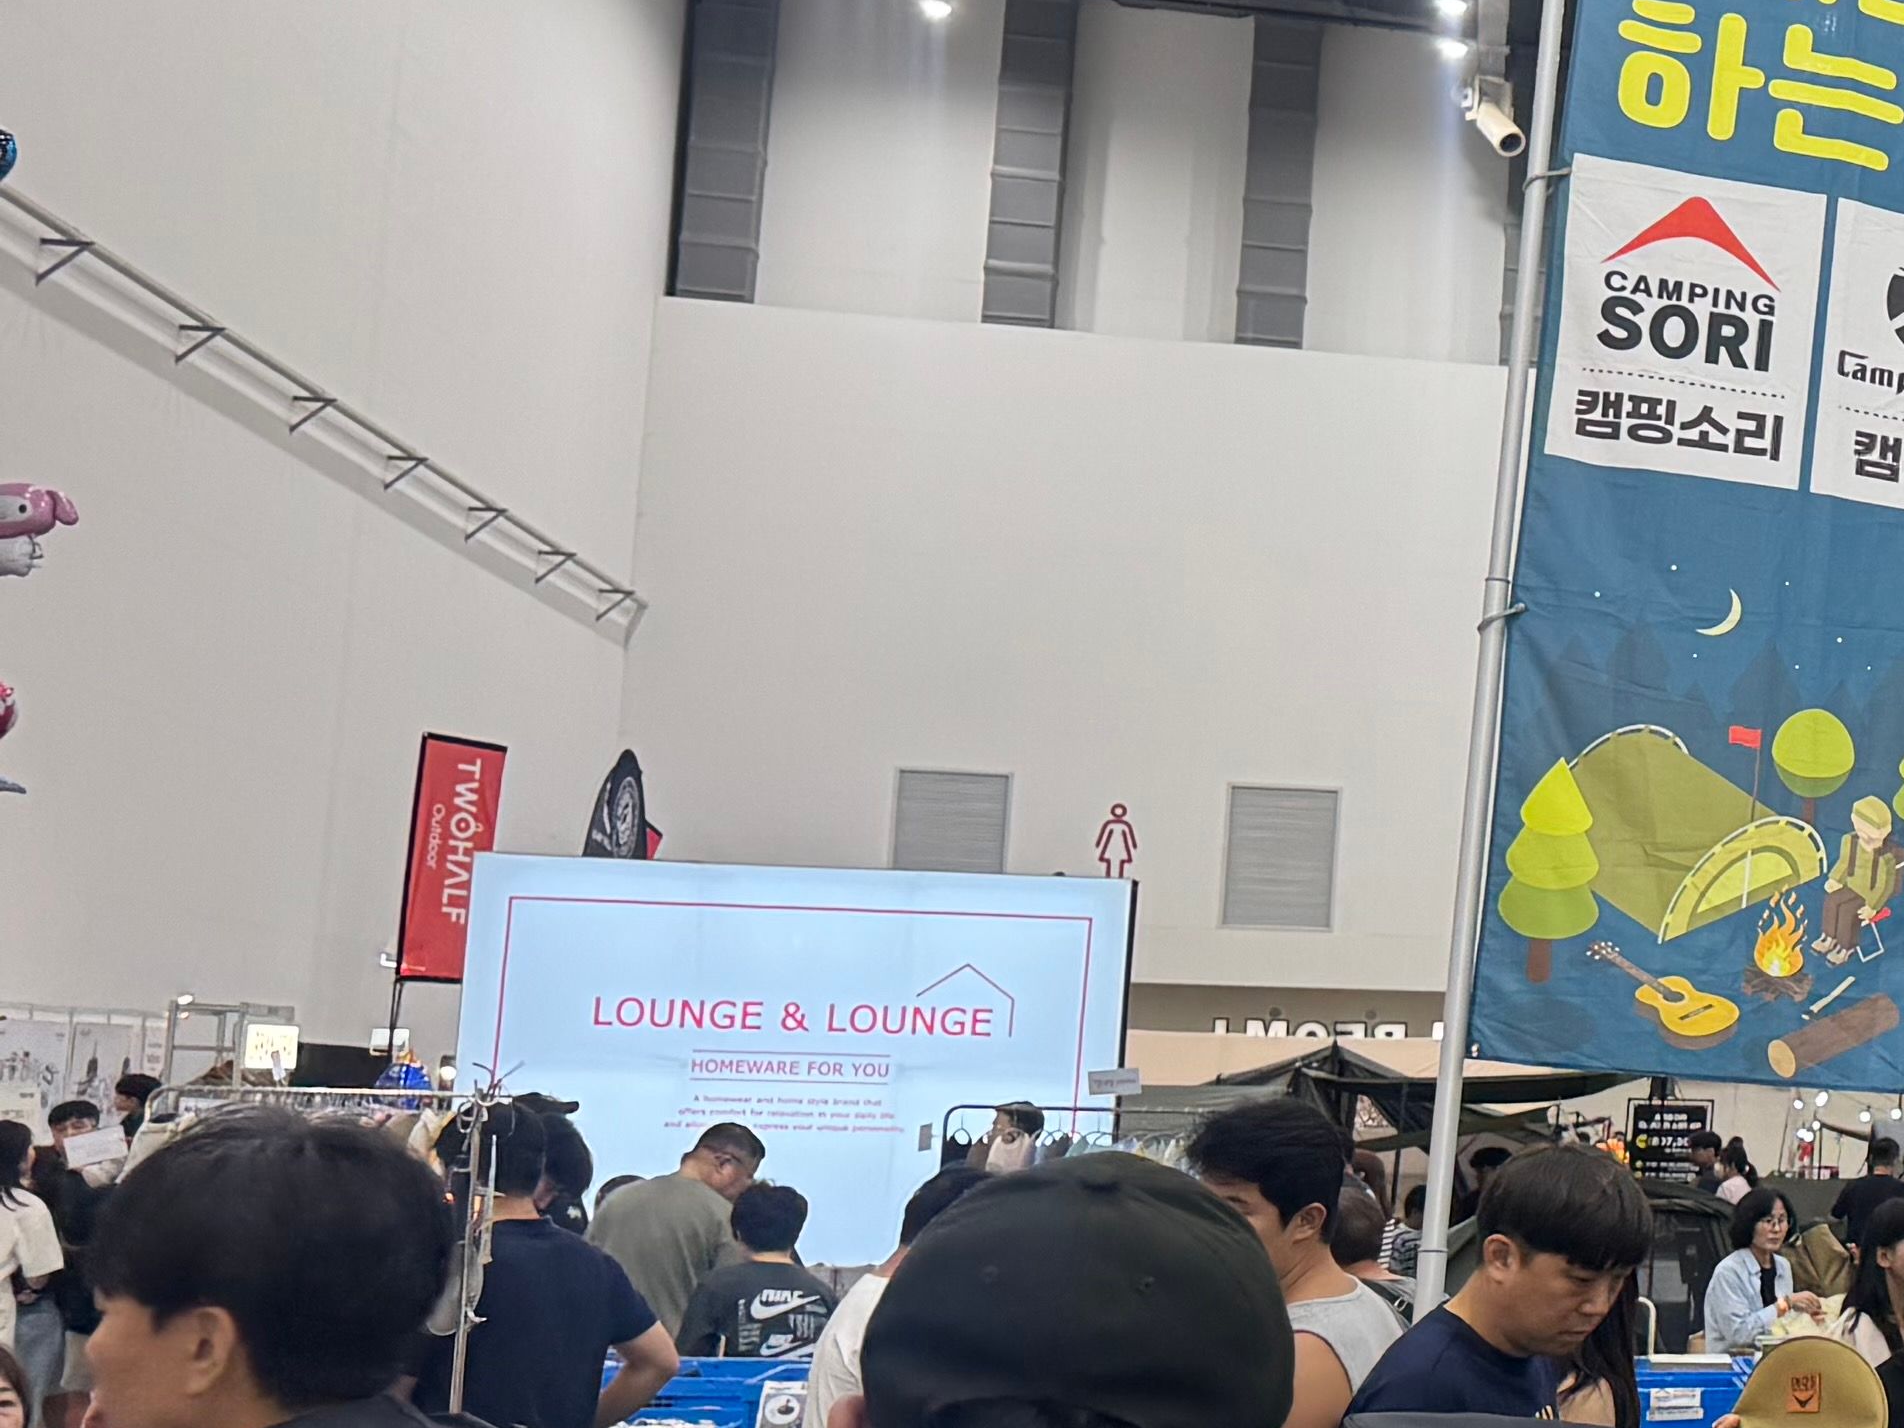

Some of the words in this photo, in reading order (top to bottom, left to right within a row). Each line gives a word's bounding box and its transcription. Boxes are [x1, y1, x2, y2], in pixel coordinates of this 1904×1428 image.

[1604, 270, 1776, 317] CAMPING
[1595, 295, 1776, 373] SORI
[1574, 388, 1785, 462] 캠핑소리
[426, 803, 446, 870] Outdoor
[592, 995, 765, 1031] LOUNGE
[780, 1002, 809, 1032] &
[827, 1002, 994, 1037] LOUNGE
[691, 1059, 800, 1077] HOMEWARE
[807, 1060, 845, 1077] FOR
[851, 1061, 890, 1078] YOU
